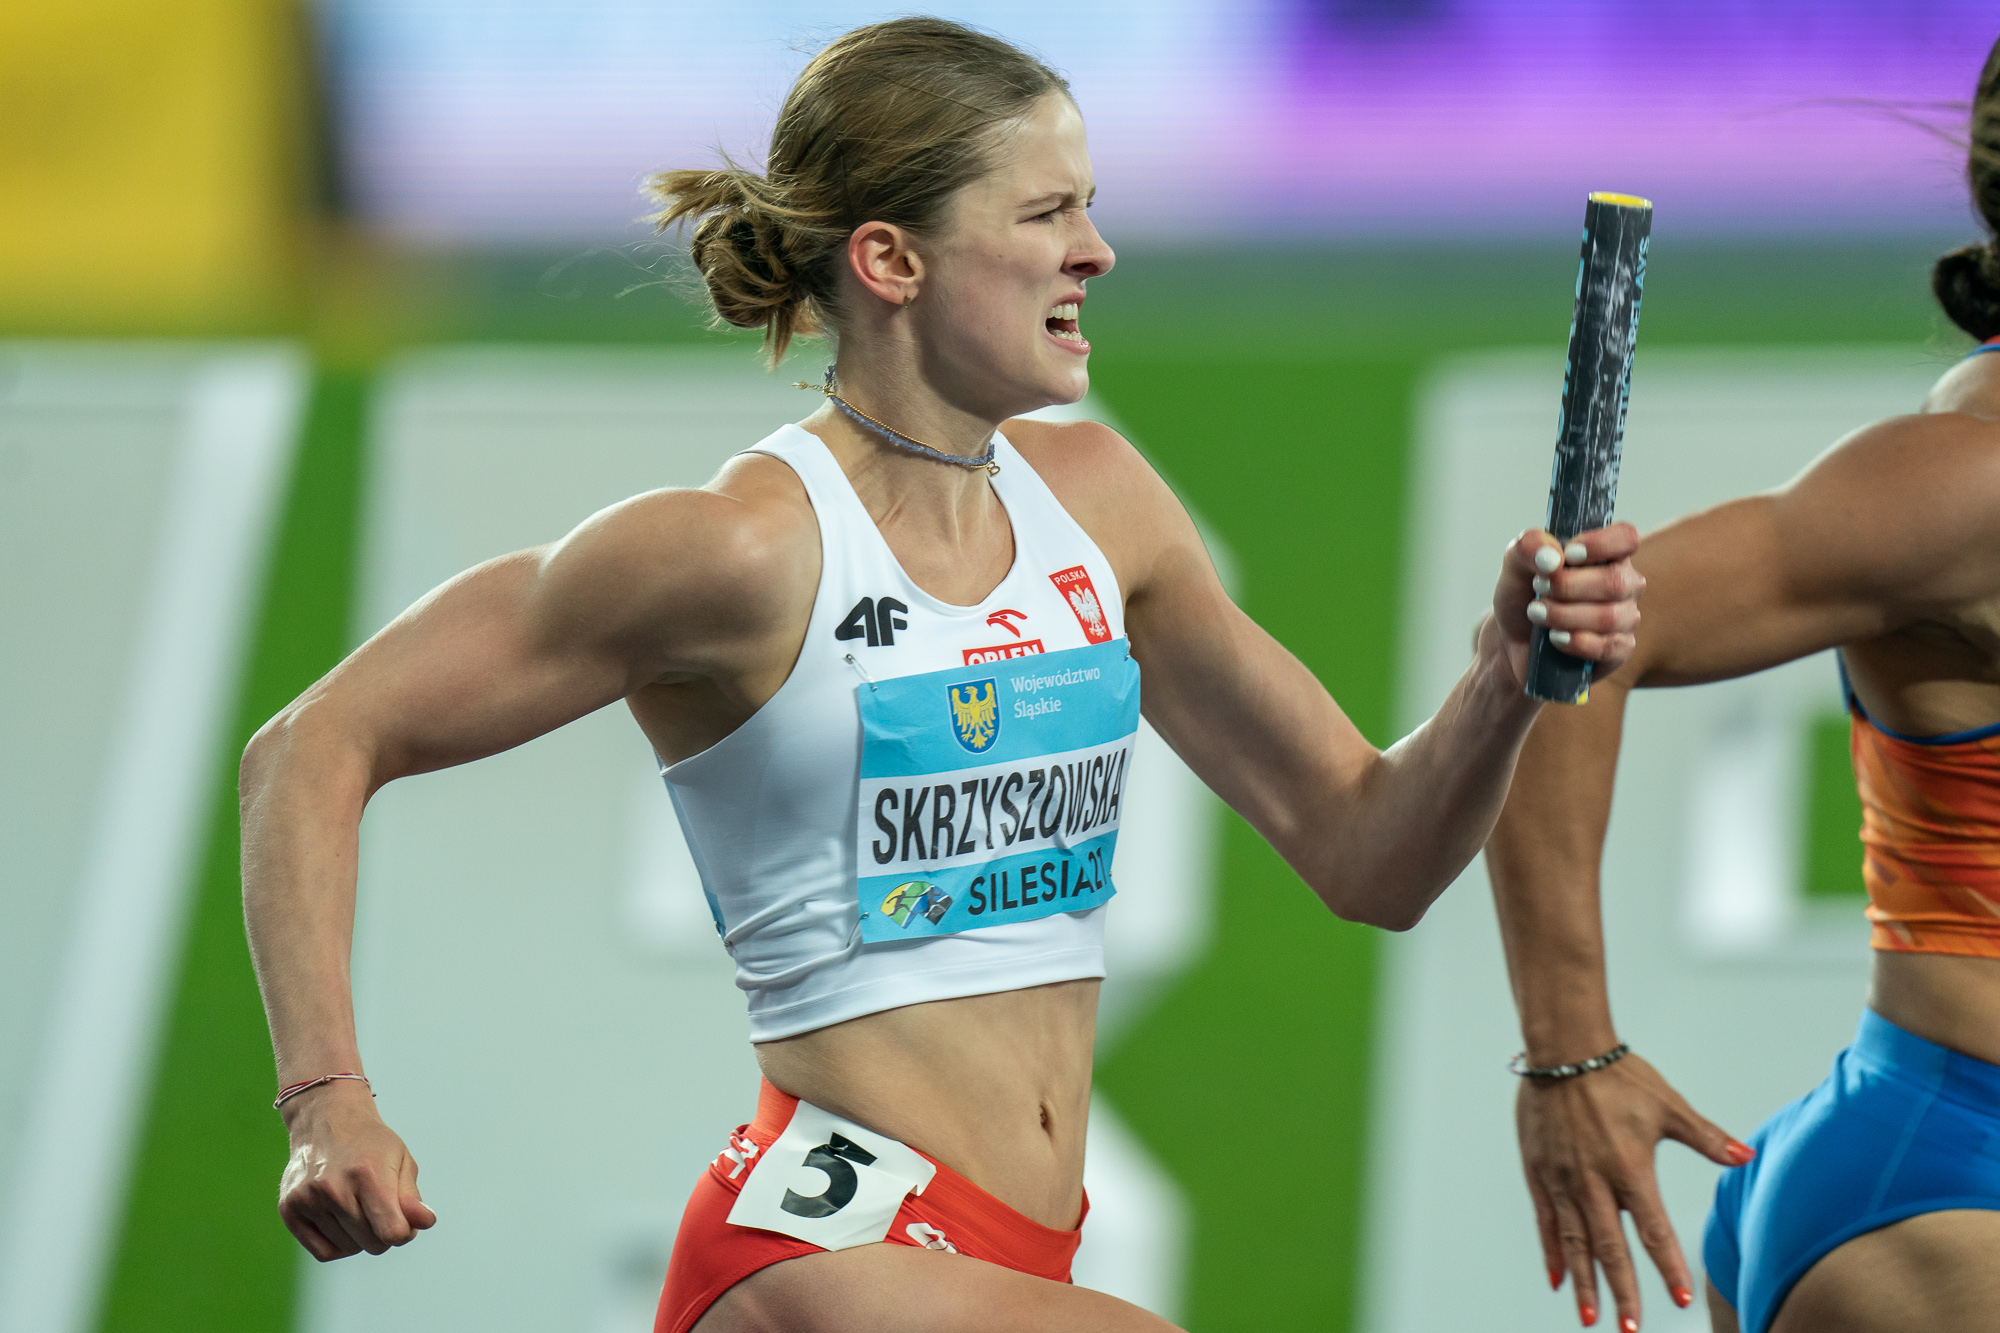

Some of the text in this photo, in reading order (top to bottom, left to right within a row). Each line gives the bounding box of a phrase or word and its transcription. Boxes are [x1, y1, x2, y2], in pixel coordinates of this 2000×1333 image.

[1627, 235, 1650, 346] RELAYS
[1054, 569, 1087, 586] POLSKA
[835, 596, 908, 647] 4F
[1010, 667, 1101, 694] Województwo
[1013, 697, 1062, 720] Śląskie
[872, 748, 1127, 865] SKRZYSZOWSKA
